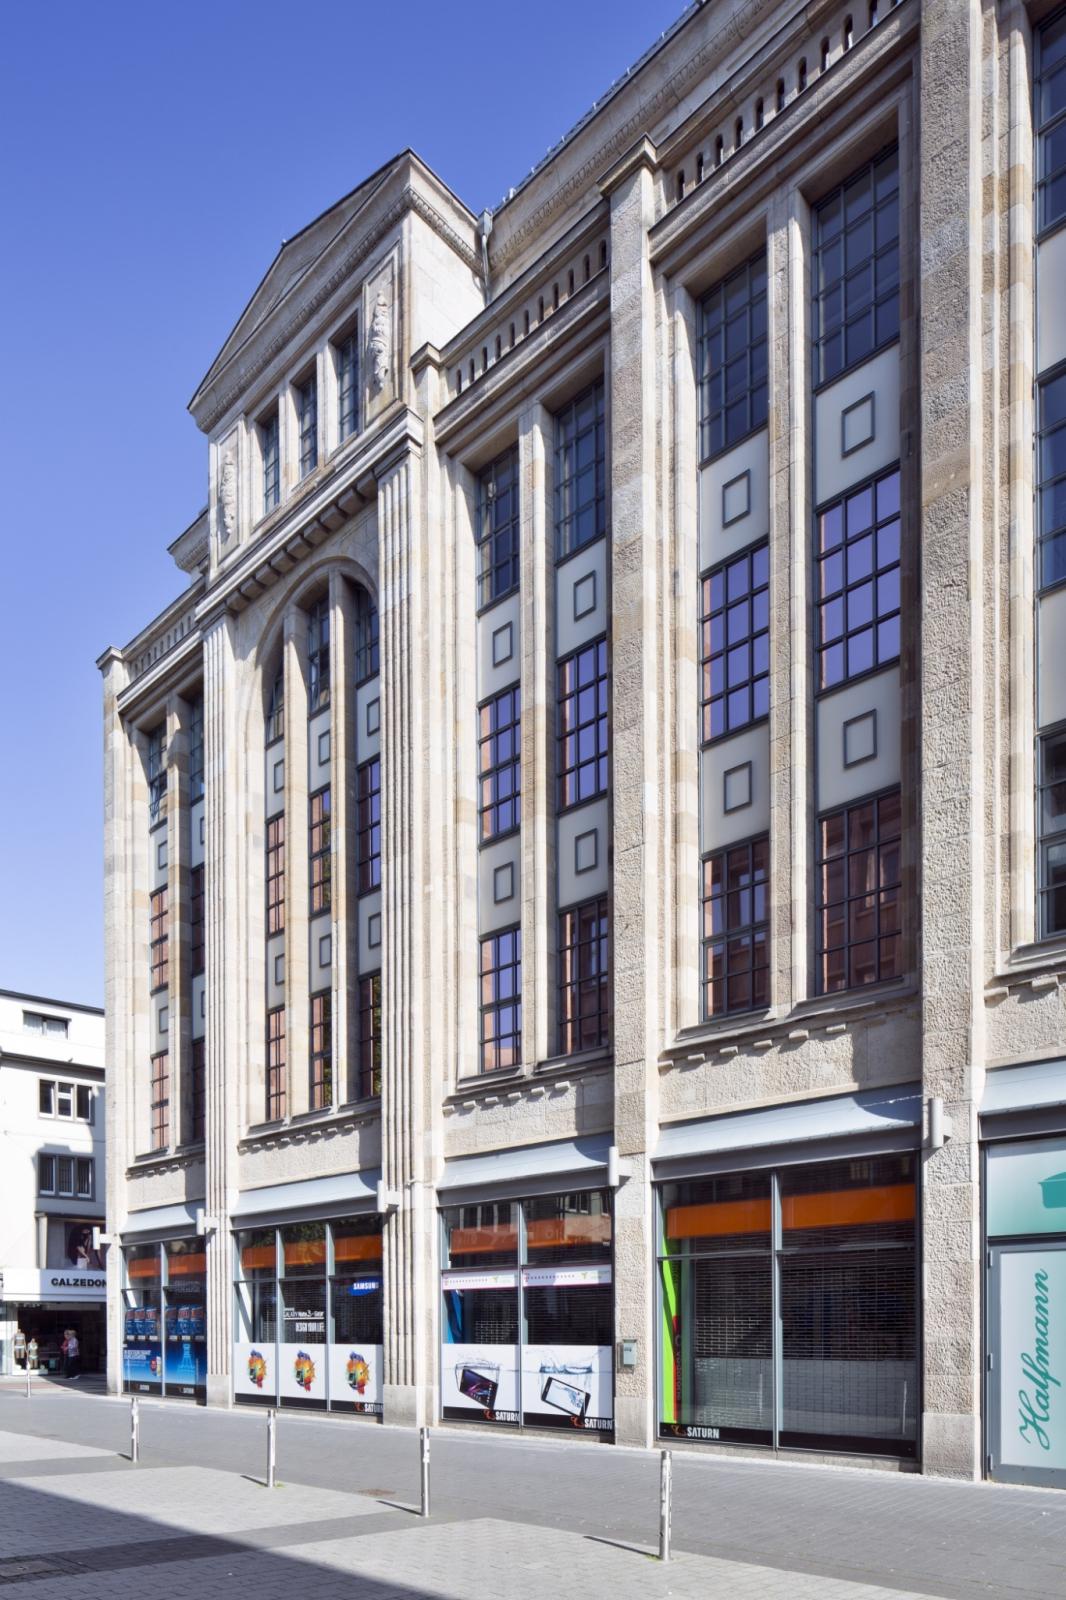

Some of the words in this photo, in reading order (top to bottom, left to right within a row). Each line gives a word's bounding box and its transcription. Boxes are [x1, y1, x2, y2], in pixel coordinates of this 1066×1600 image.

[1019, 1269, 1061, 1450] Halfmann
[495, 1411, 520, 1421] SATURN
[584, 1418, 613, 1429] SATURN
[687, 1427, 719, 1438] SATURN
